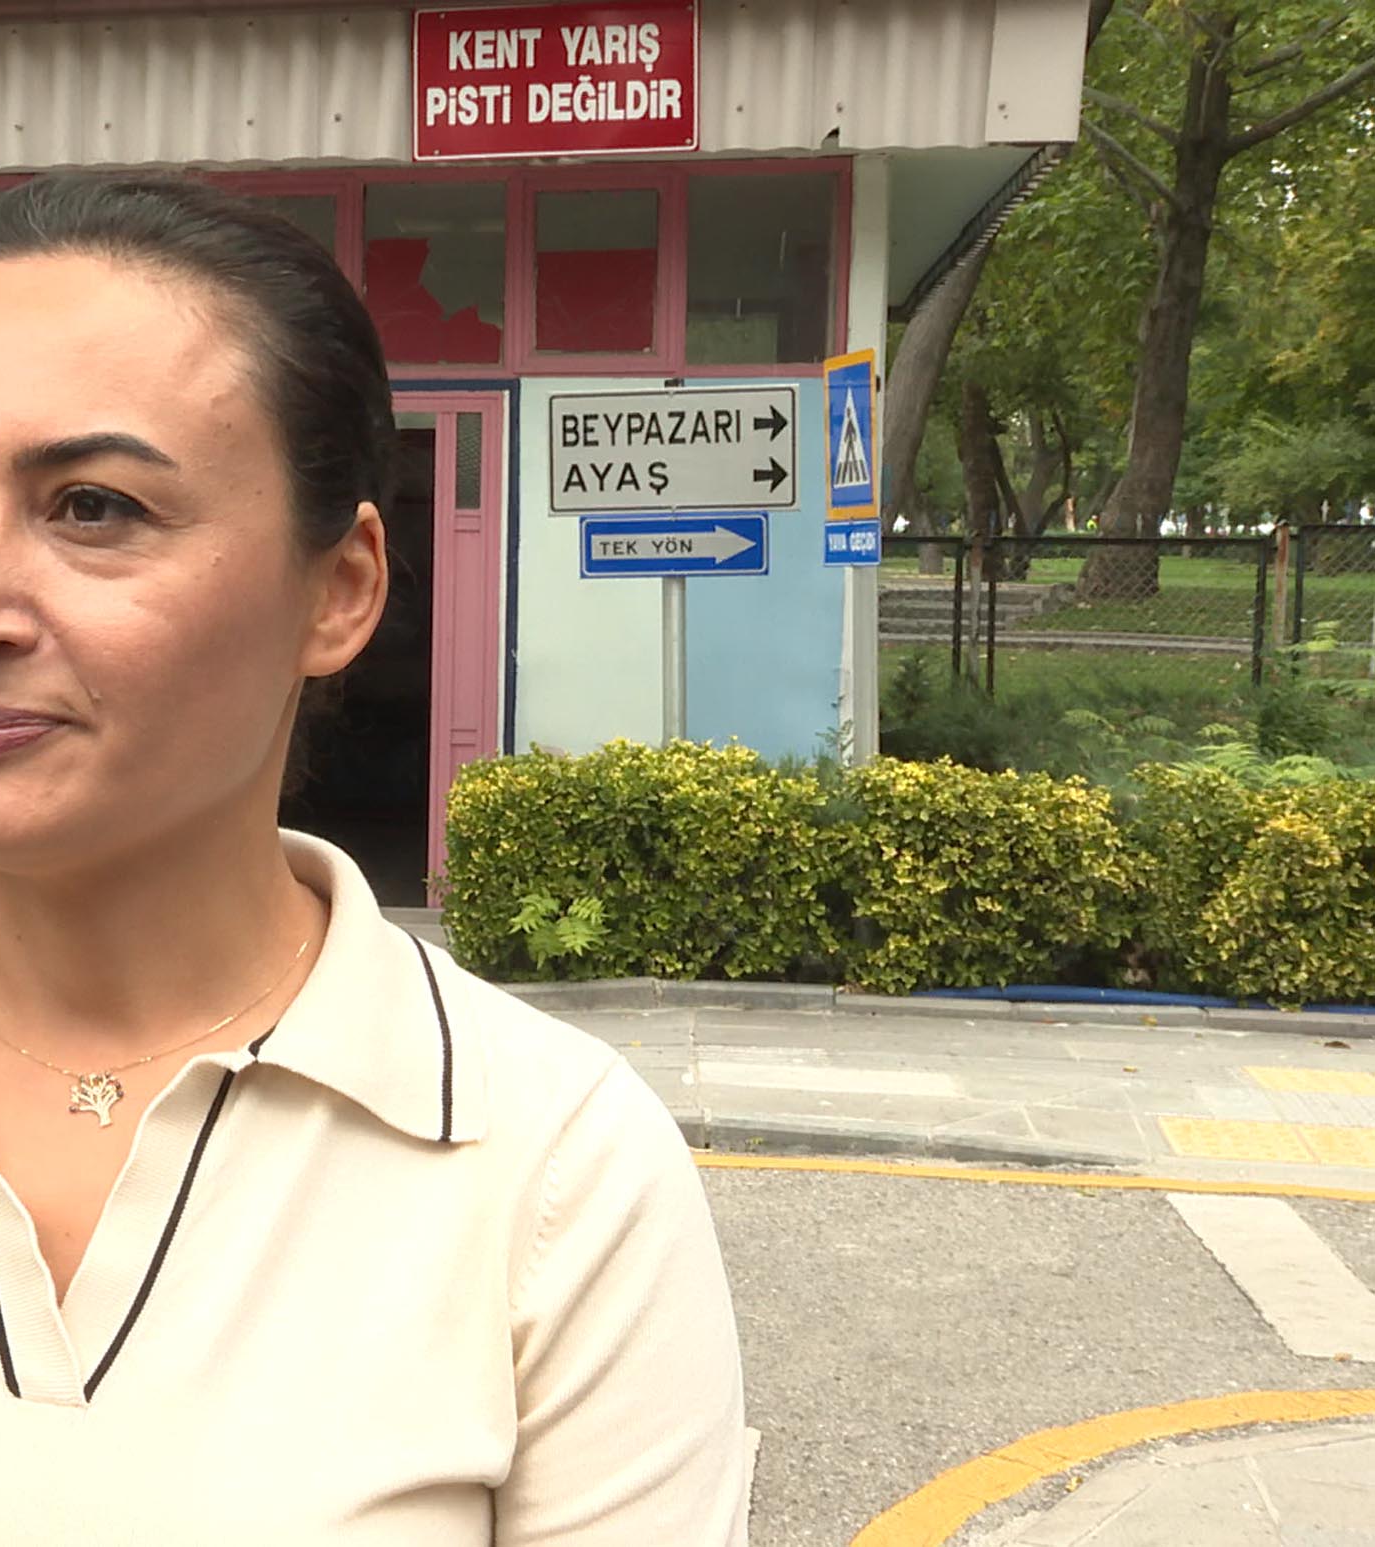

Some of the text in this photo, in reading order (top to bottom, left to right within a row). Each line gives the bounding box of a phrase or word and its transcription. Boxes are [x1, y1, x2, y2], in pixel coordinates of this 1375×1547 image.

[448, 23, 660, 73] KENT YARIŞ
[561, 409, 741, 448] BEYPAZARI
[562, 461, 670, 496] AYAŞ
[599, 537, 693, 556] TEK YÖN
